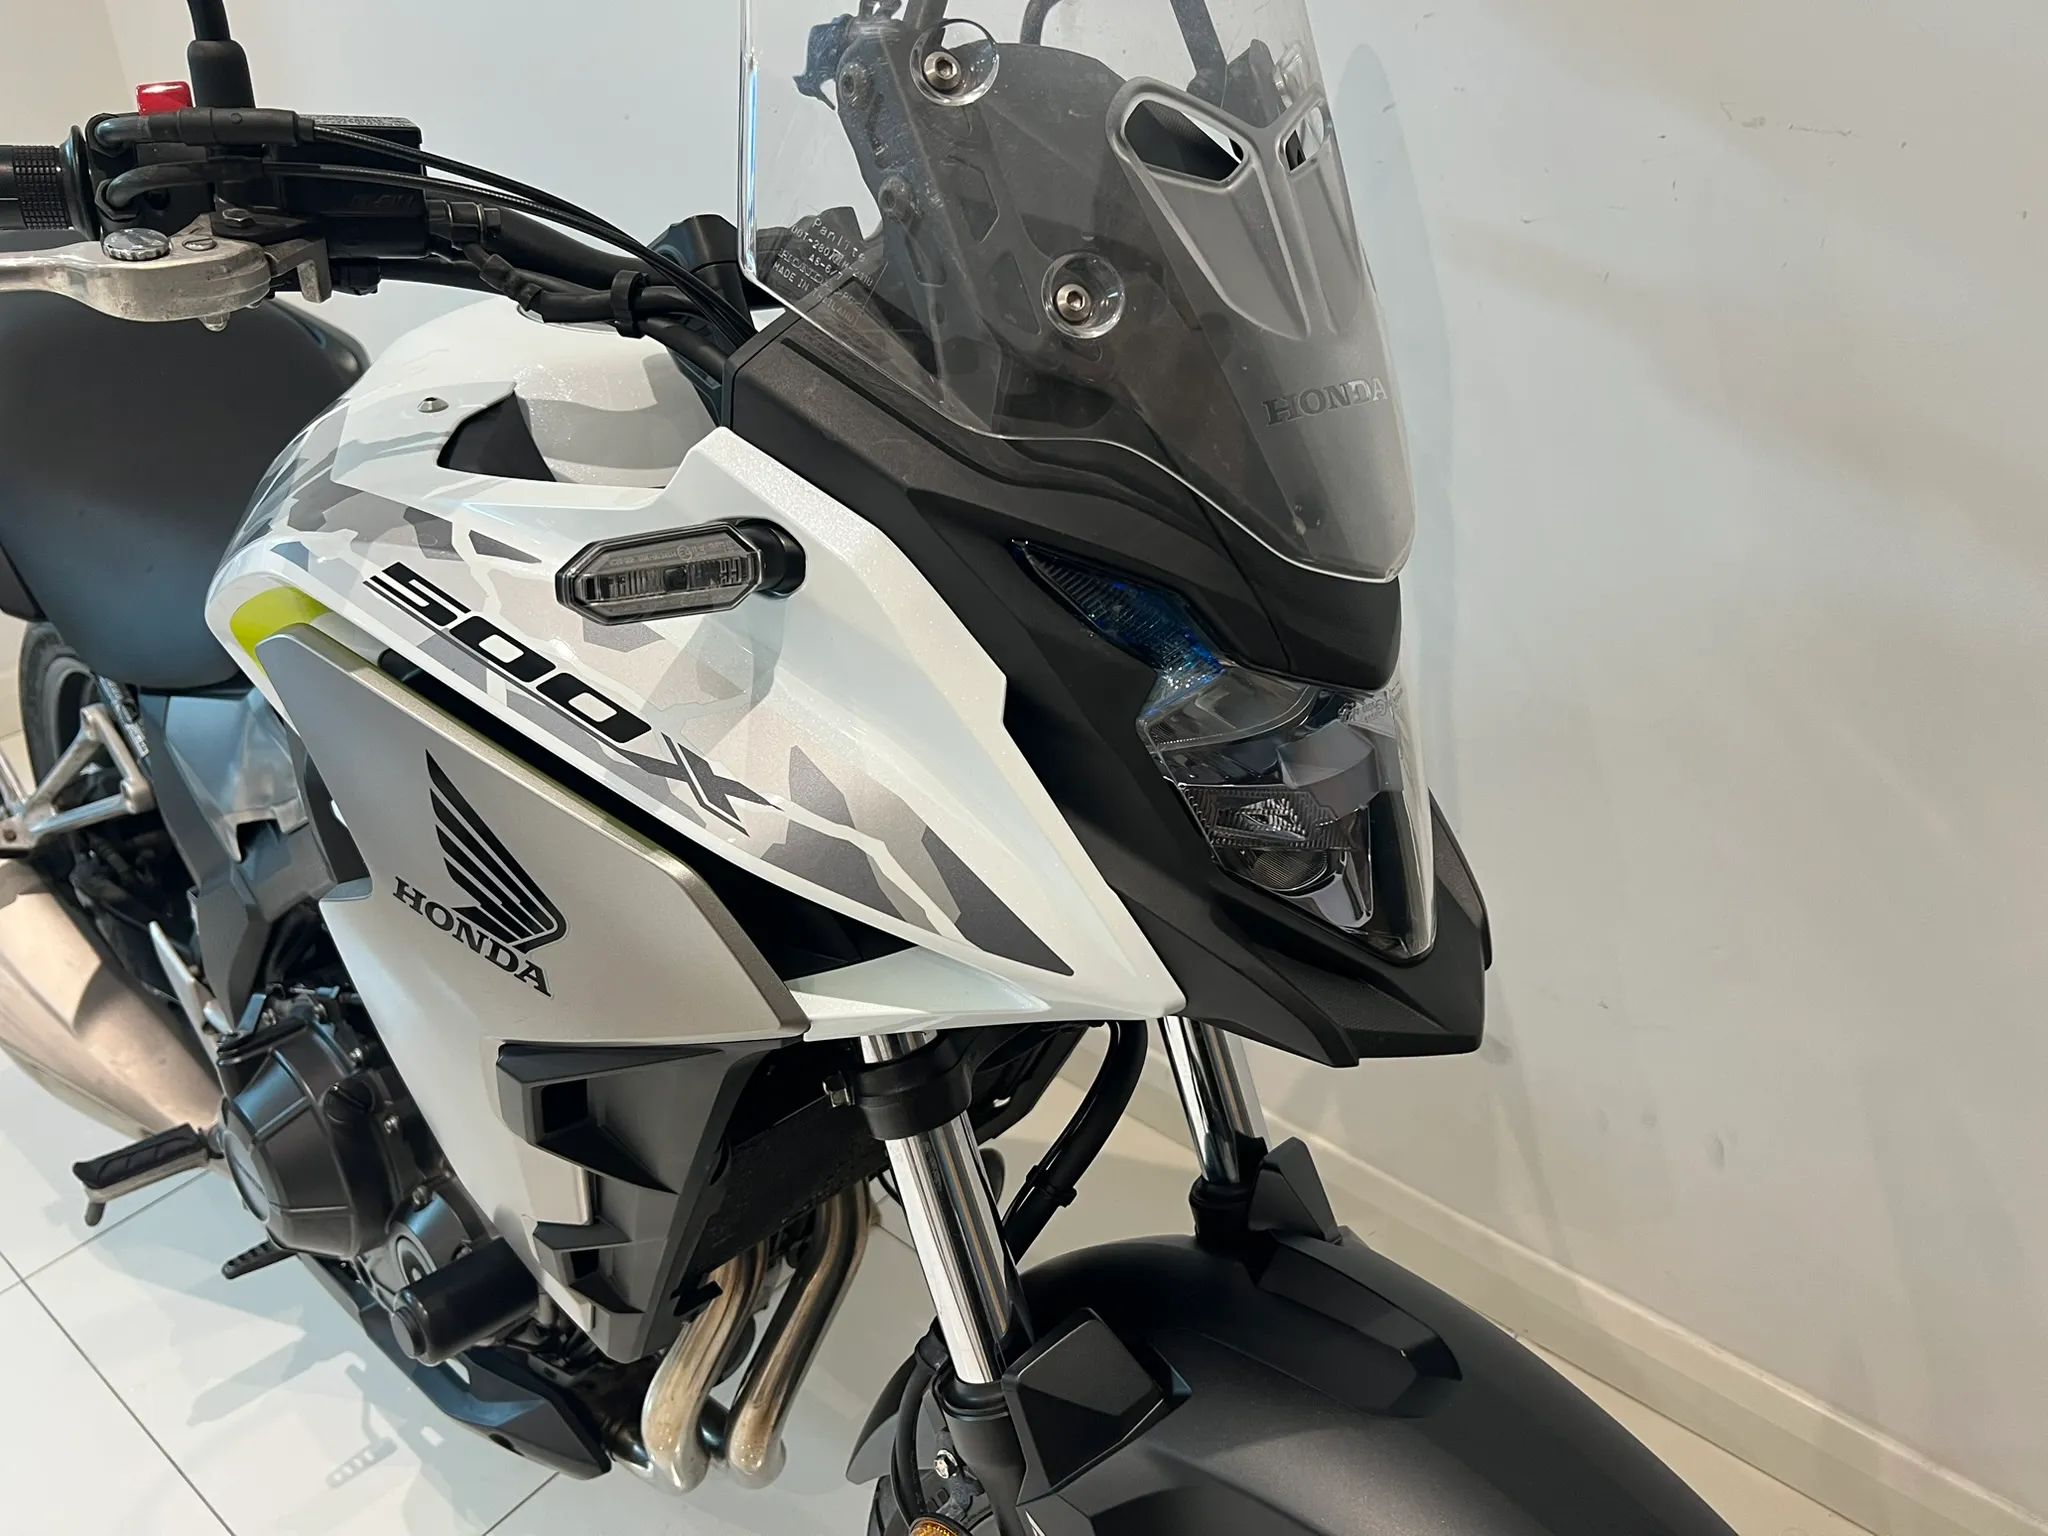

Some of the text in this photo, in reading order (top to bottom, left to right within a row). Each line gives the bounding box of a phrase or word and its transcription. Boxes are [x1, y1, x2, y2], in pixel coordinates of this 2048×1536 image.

[812, 218, 866, 263] Panlite
[772, 261, 796, 283] MADE
[797, 278, 810, 292] IN
[1262, 378, 1388, 426] HONDA
[393, 876, 552, 997] HONDA
